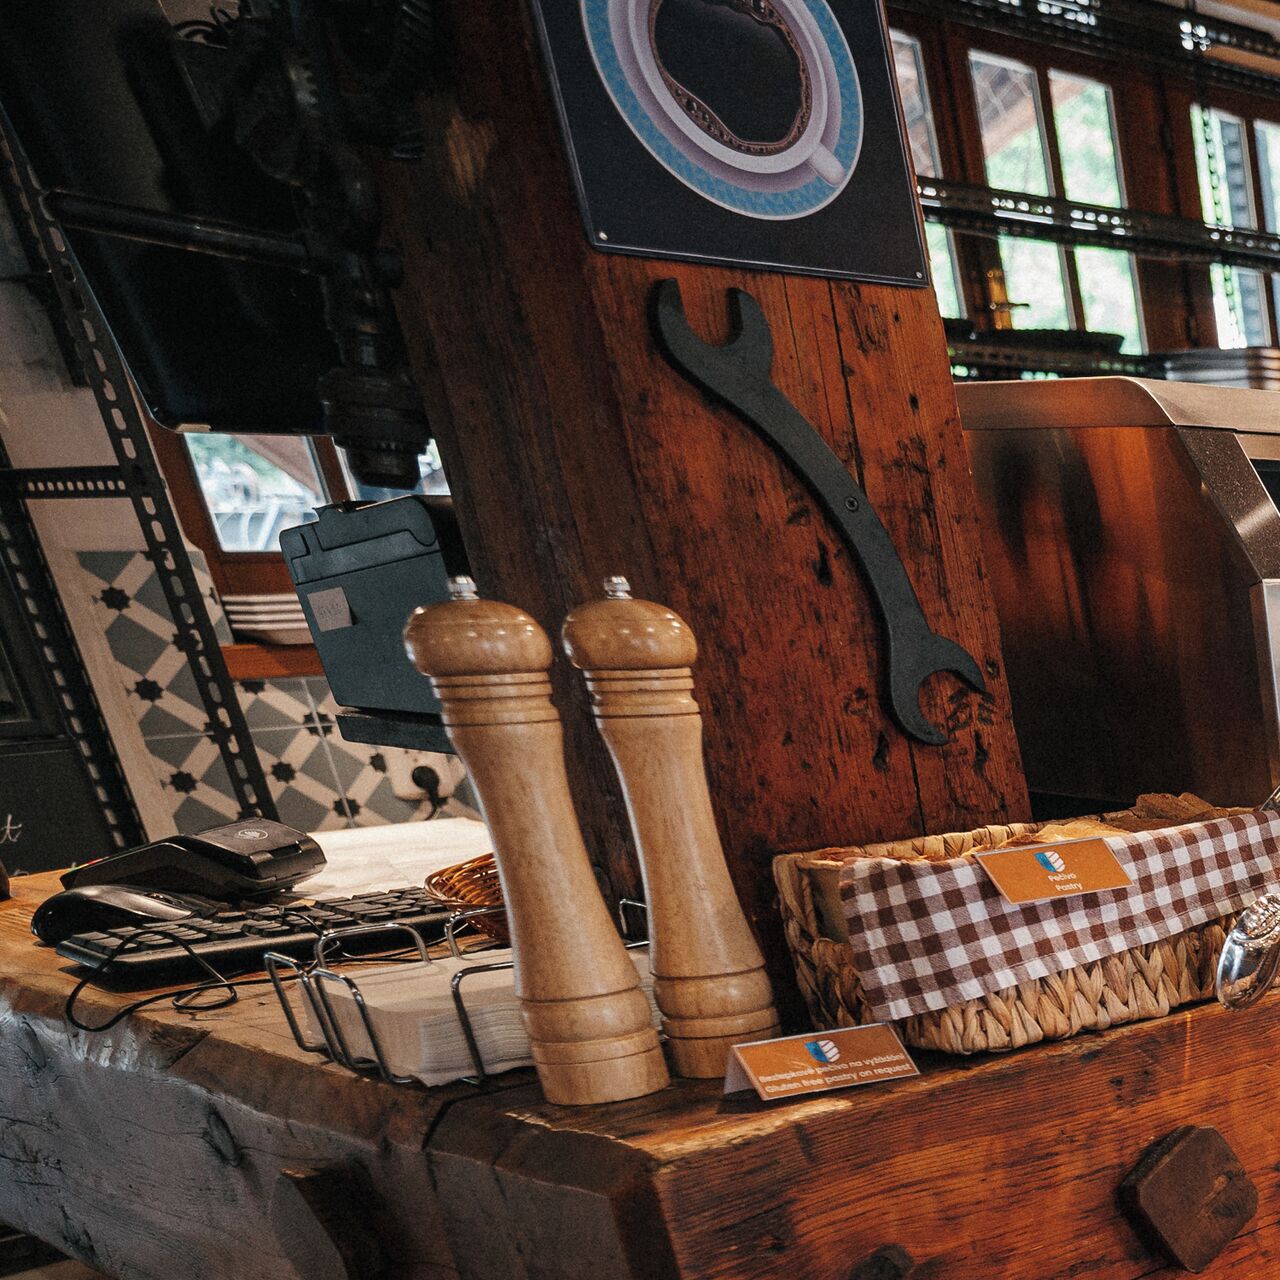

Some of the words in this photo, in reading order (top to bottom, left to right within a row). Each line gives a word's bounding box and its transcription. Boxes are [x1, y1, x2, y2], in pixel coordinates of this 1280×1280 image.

[1056, 882, 1083, 891] Pastry
[825, 1073, 857, 1084] pastry
[859, 1069, 873, 1077] on
[874, 1063, 912, 1075] request
